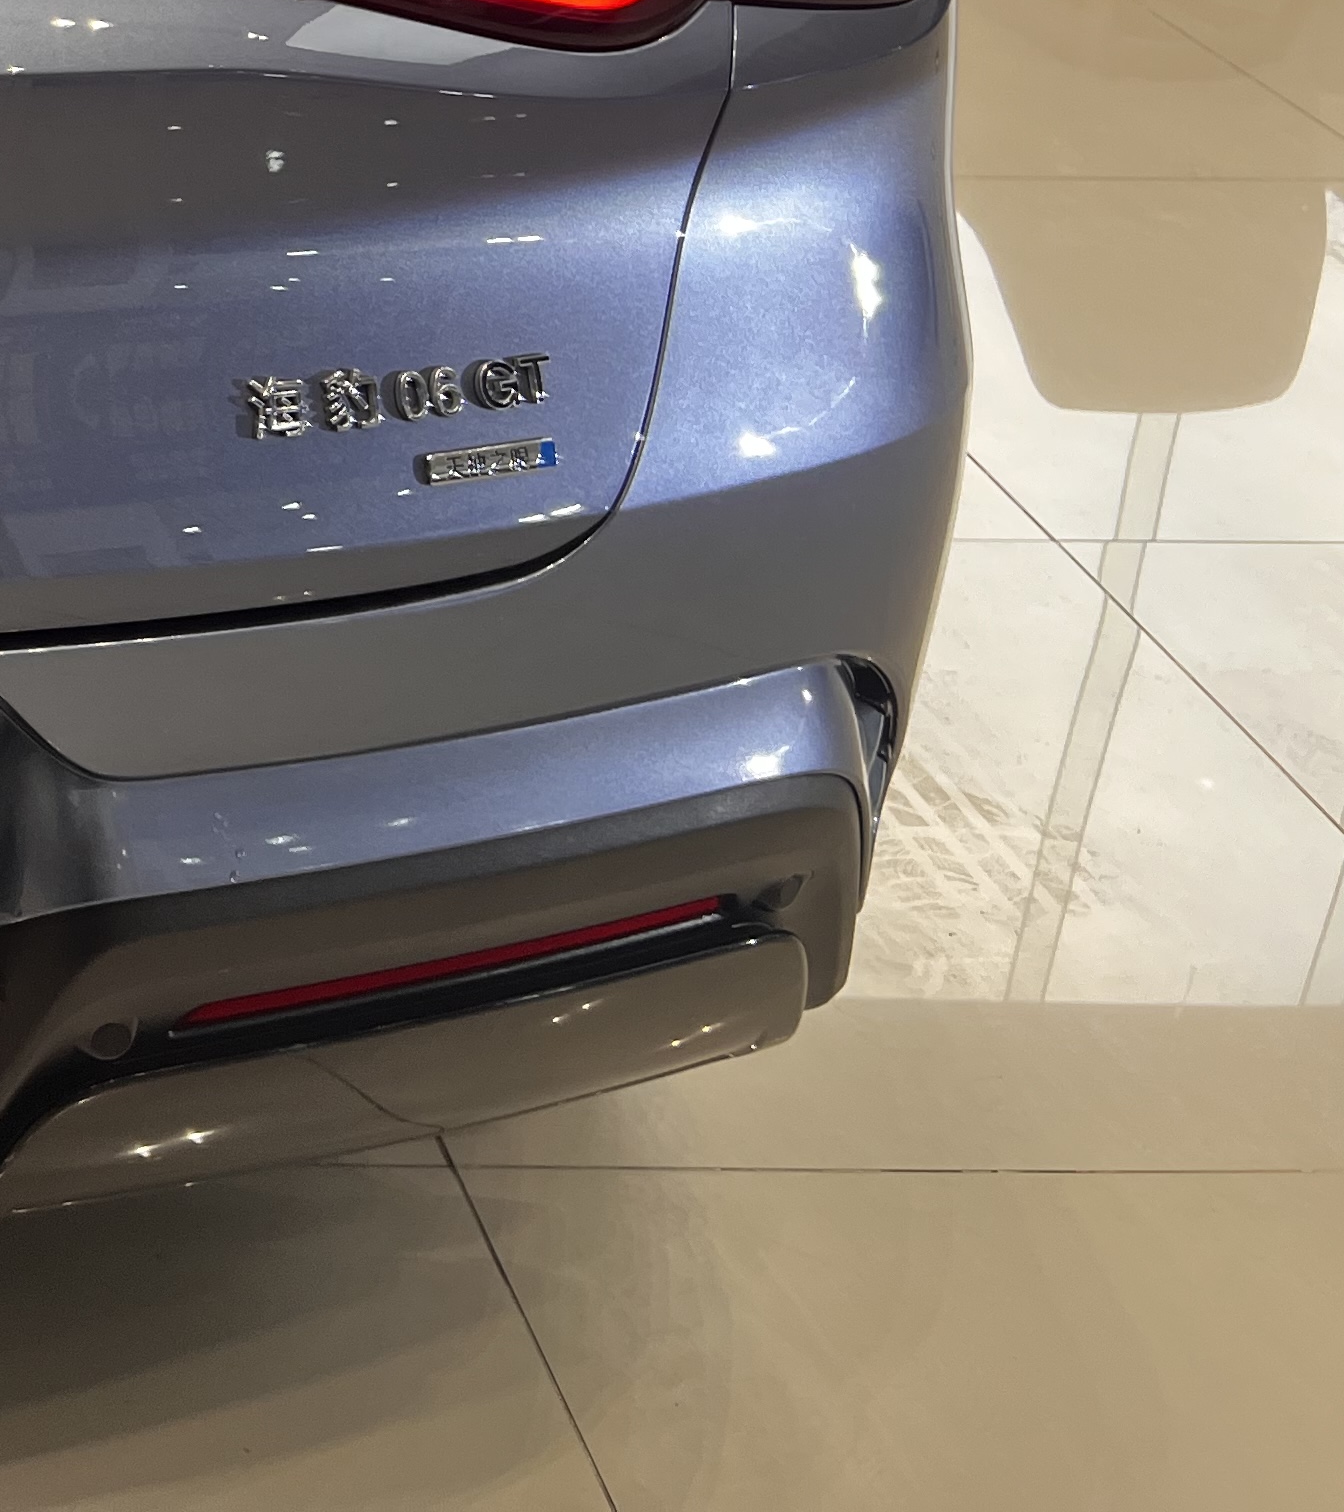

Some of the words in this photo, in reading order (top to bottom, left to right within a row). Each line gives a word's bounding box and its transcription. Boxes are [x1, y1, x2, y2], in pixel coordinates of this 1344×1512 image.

[246, 368, 386, 440] 海豹
[394, 366, 467, 422] 06
[472, 352, 551, 411] GT
